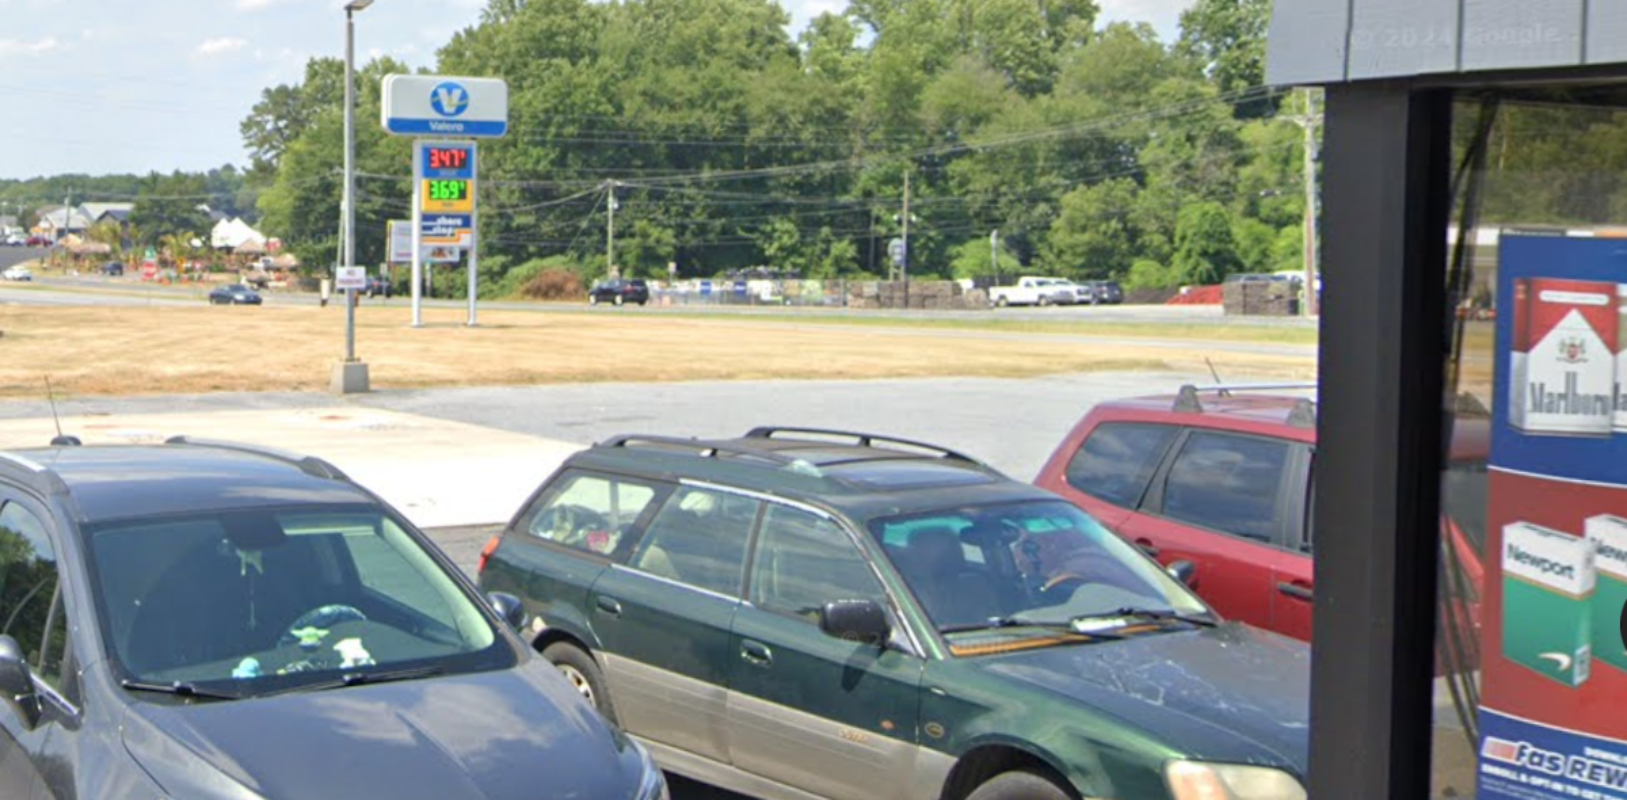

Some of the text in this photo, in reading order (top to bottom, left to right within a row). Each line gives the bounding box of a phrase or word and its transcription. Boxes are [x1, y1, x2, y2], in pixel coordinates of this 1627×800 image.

[429, 120, 465, 132] Valero
[1529, 371, 1610, 416] Marlboro
[1507, 543, 1575, 580] Newport
[1515, 742, 1564, 774] fas
